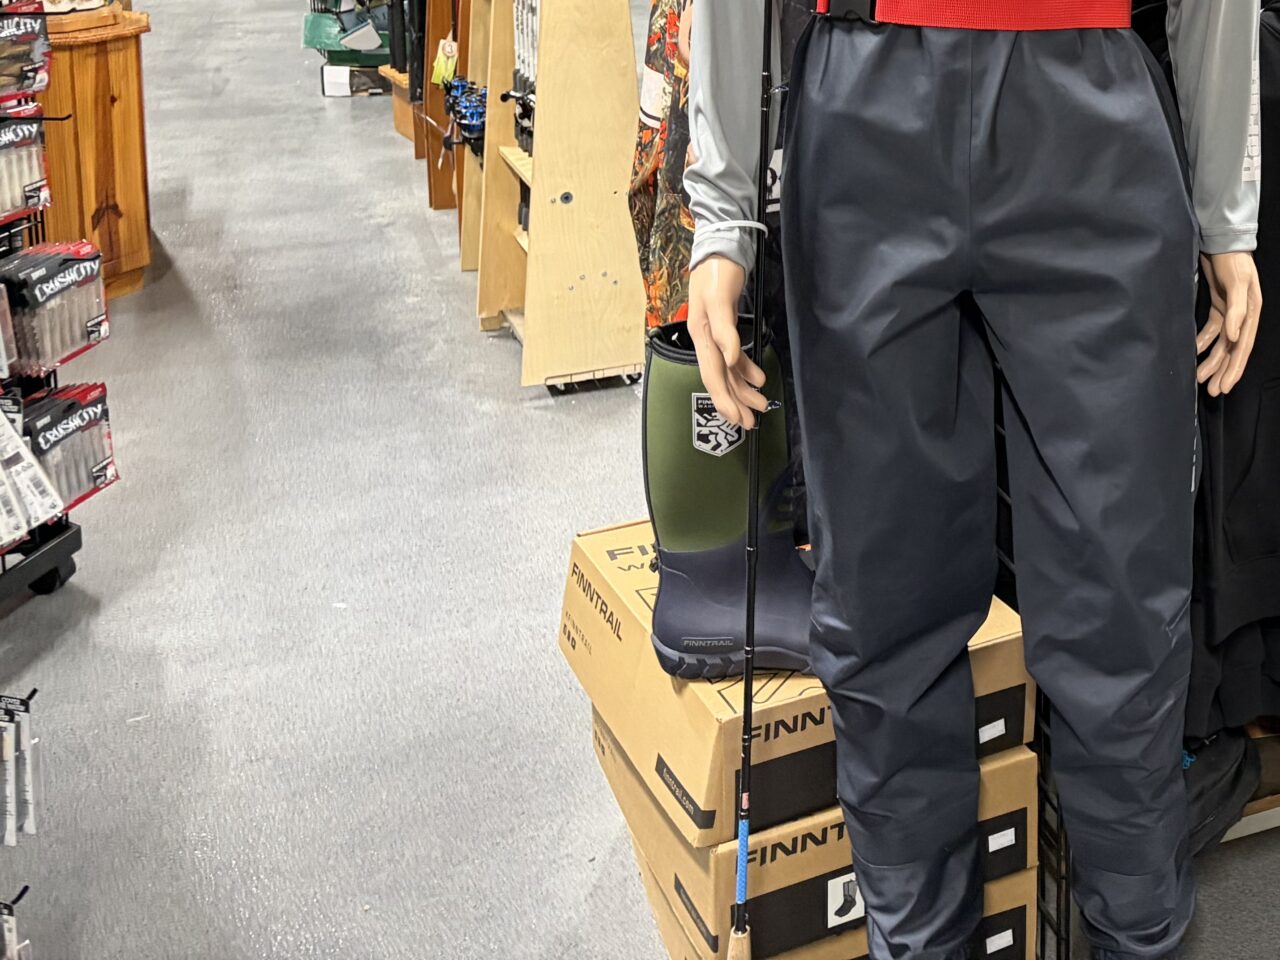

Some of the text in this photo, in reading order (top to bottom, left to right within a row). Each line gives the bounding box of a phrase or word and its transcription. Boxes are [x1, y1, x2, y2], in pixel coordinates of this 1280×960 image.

[34, 259, 101, 303] CRUSHCITY
[37, 402, 104, 451] CRUSHCITY
[571, 561, 623, 643] FINNTRAIL
[683, 639, 734, 647] FINNTRAIL
